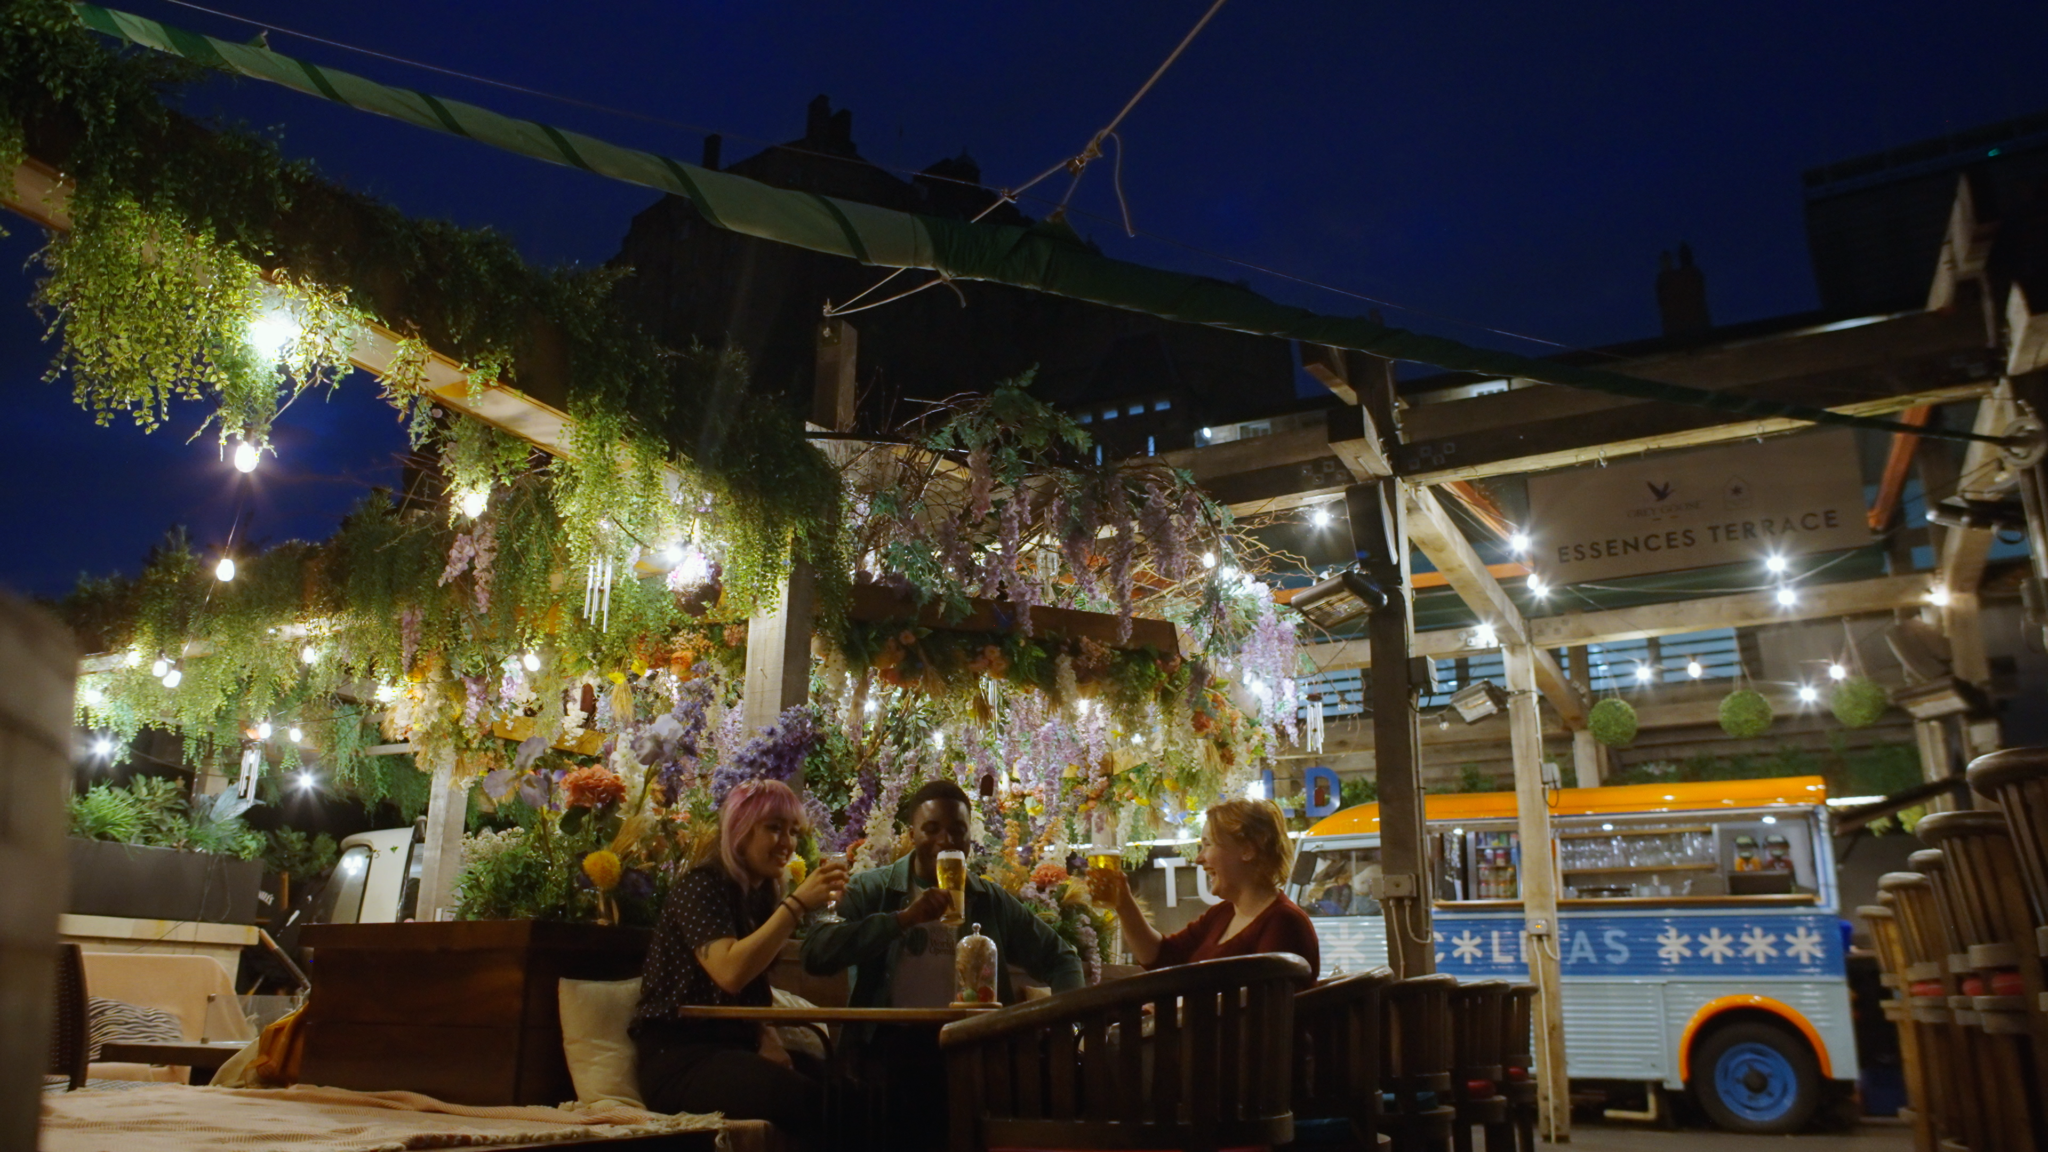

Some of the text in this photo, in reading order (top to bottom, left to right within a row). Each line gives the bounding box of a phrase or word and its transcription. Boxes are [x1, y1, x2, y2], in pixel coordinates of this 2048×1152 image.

[1557, 509, 1840, 564] ESSENCES TERRACE
[1564, 929, 1631, 965] AS
